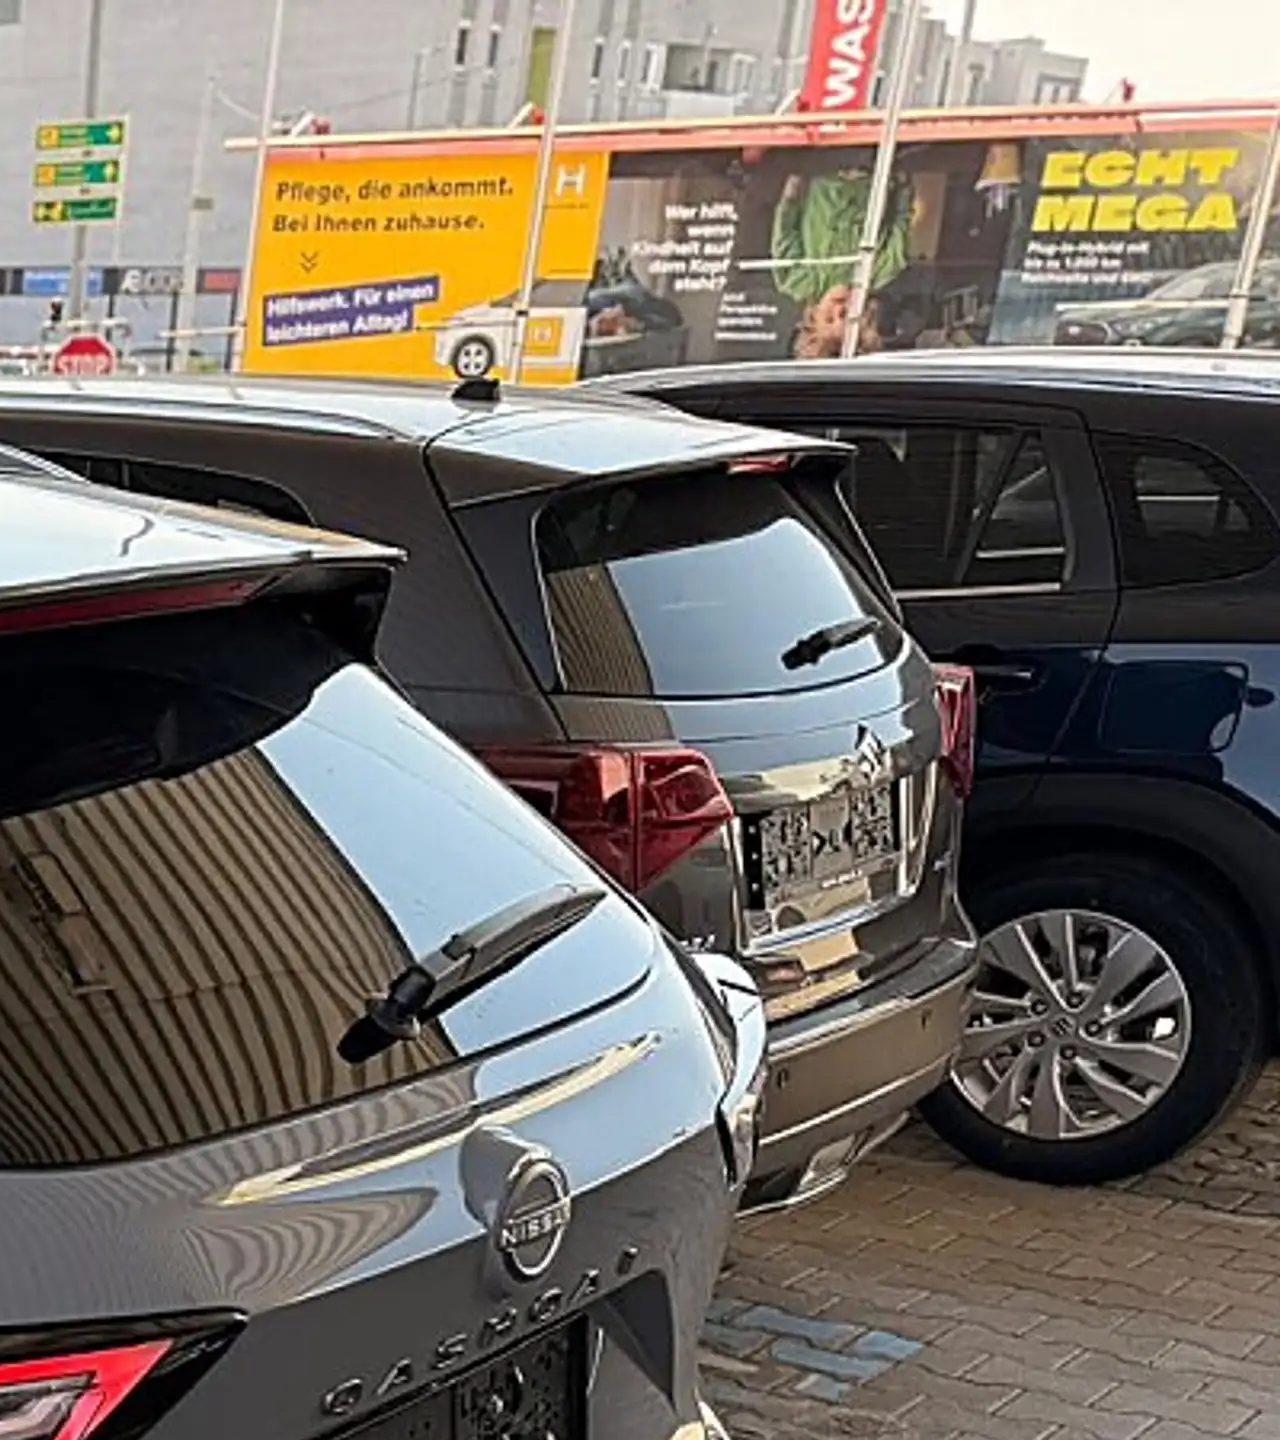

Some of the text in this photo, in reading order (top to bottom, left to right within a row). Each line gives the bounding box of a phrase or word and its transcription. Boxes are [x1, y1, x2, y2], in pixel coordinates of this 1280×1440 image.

[1042, 149, 1238, 188] ECHT
[276, 175, 514, 206] Pflege, die ankommt.
[272, 208, 484, 233] Bei Ihnen zuhause.
[1031, 192, 1237, 232] MEGA
[57, 352, 107, 375] STOP
[320, 1247, 640, 1415] QASHQAI
